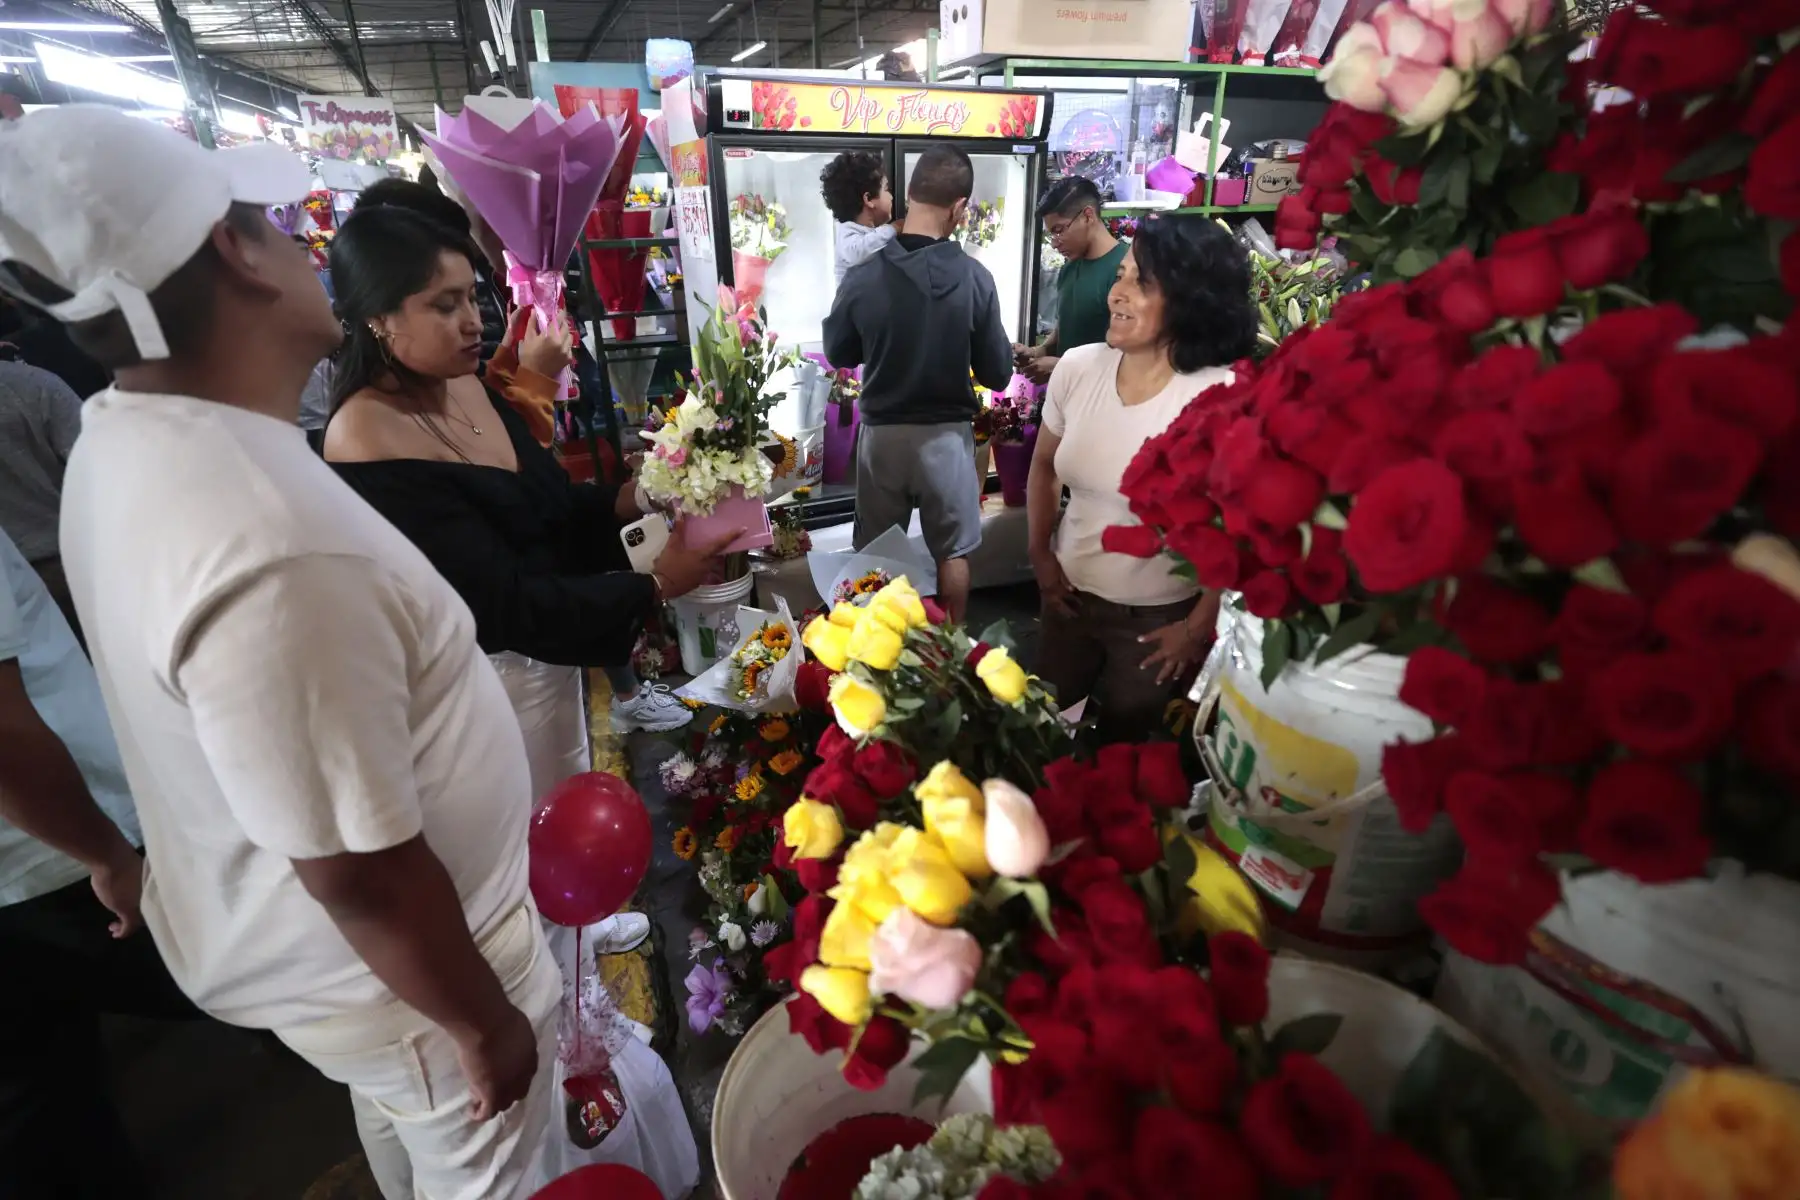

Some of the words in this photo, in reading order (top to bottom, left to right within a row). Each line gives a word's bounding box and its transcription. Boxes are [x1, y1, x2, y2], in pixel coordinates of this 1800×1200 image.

[1056, 9, 1088, 22] flowers
[1090, 11, 1128, 22] premium
[830, 86, 883, 133] Vip
[887, 90, 971, 133] Flowers
